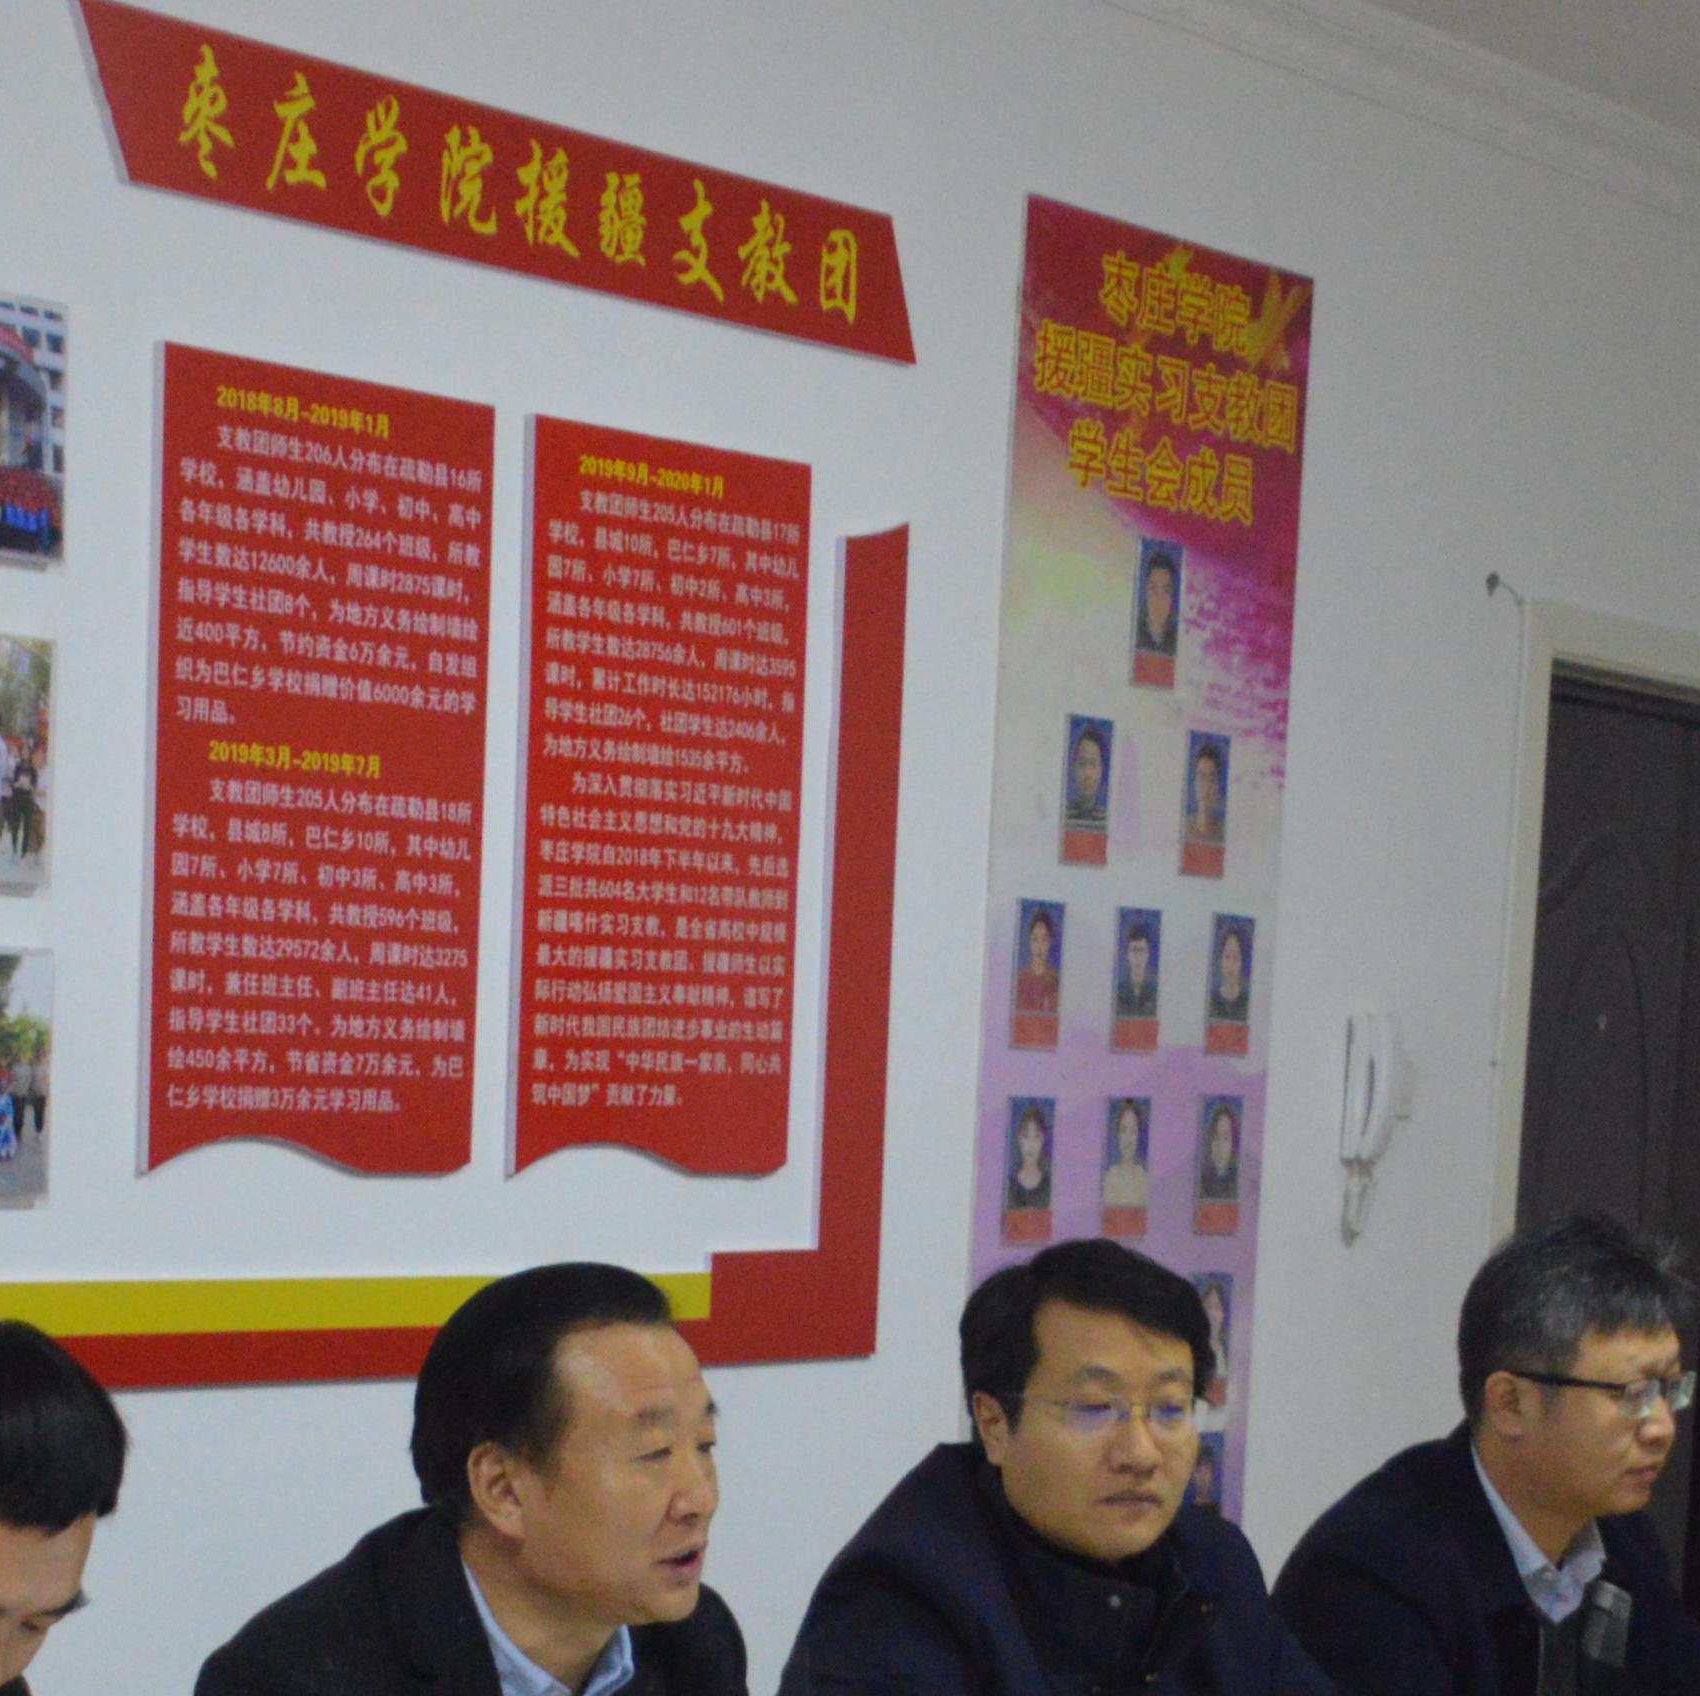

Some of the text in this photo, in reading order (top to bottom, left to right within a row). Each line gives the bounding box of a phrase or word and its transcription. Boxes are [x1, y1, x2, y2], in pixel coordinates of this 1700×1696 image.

[178, 44, 859, 326] 枣庄学院援疆支教团
[1099, 250, 1252, 355] 枣庄学院
[1034, 318, 1299, 455] 援疆实习支教团
[1067, 417, 1254, 527] 学生会成员
